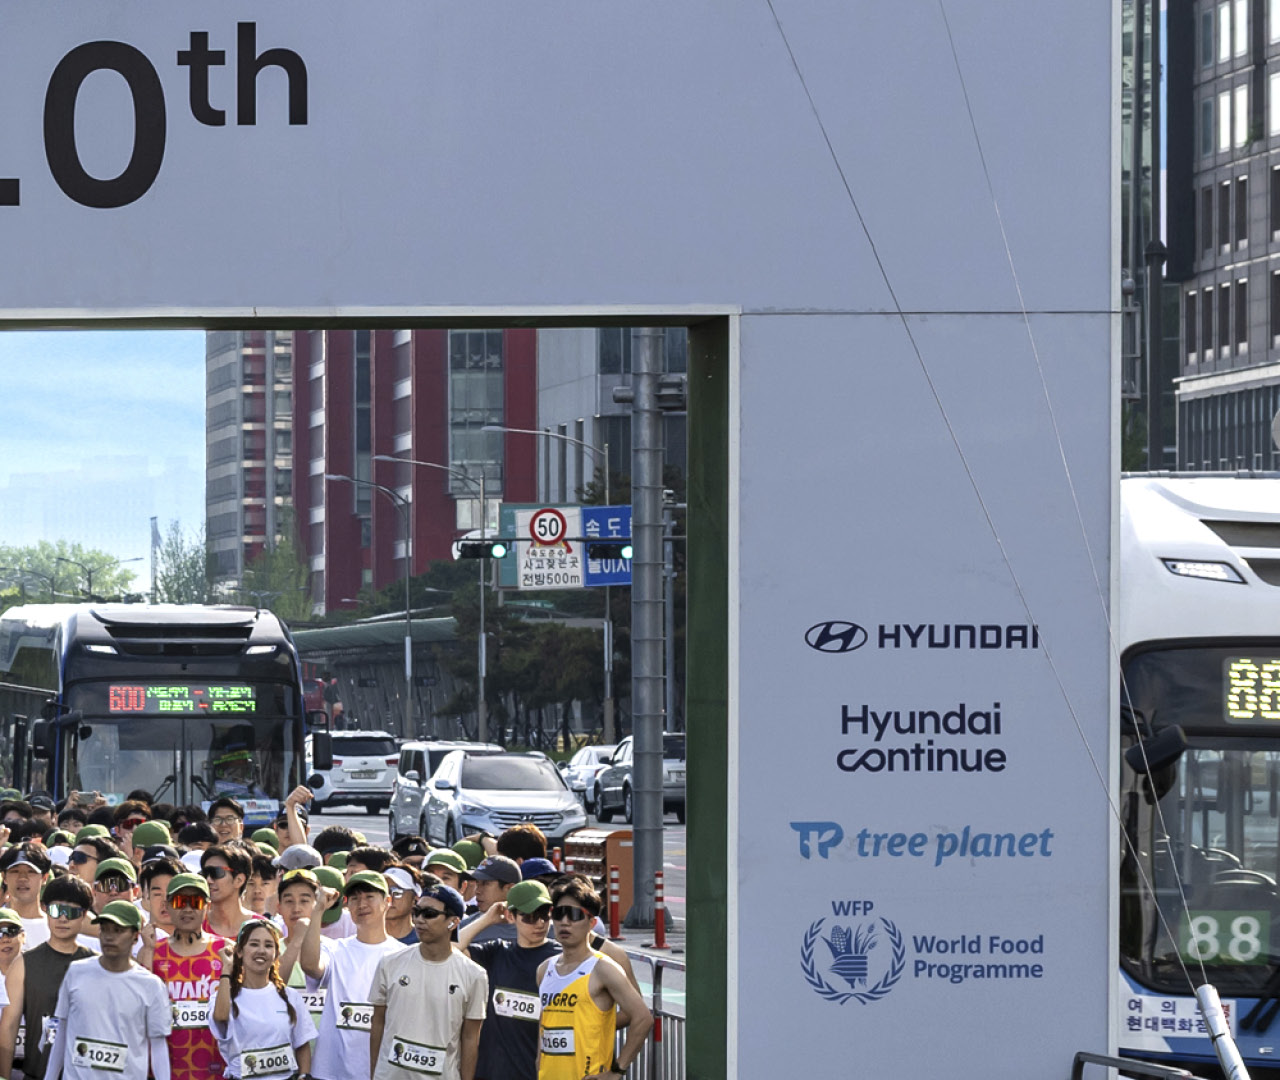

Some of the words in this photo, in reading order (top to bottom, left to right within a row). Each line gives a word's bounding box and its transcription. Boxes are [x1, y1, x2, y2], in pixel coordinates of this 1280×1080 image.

[538, 518, 559, 537] 50
[522, 573, 581, 586] 전방500m
[878, 624, 1039, 649] HYUNDAI
[109, 685, 145, 711] 600
[841, 703, 1001, 741] Hyundai
[837, 740, 1006, 772] continue
[857, 828, 927, 857] tree
[935, 825, 1054, 867] planet
[832, 901, 874, 916] WFP
[913, 934, 981, 954] World
[989, 934, 1043, 954] Food
[1187, 915, 1262, 962] 88
[913, 960, 1044, 984] Programme
[506, 999, 535, 1014] 1208
[541, 992, 578, 1007] BIGRC
[353, 1012, 373, 1024] 06
[88, 1050, 120, 1064] 1027
[259, 1055, 290, 1069] 1008
[403, 1051, 436, 1067] 0493
